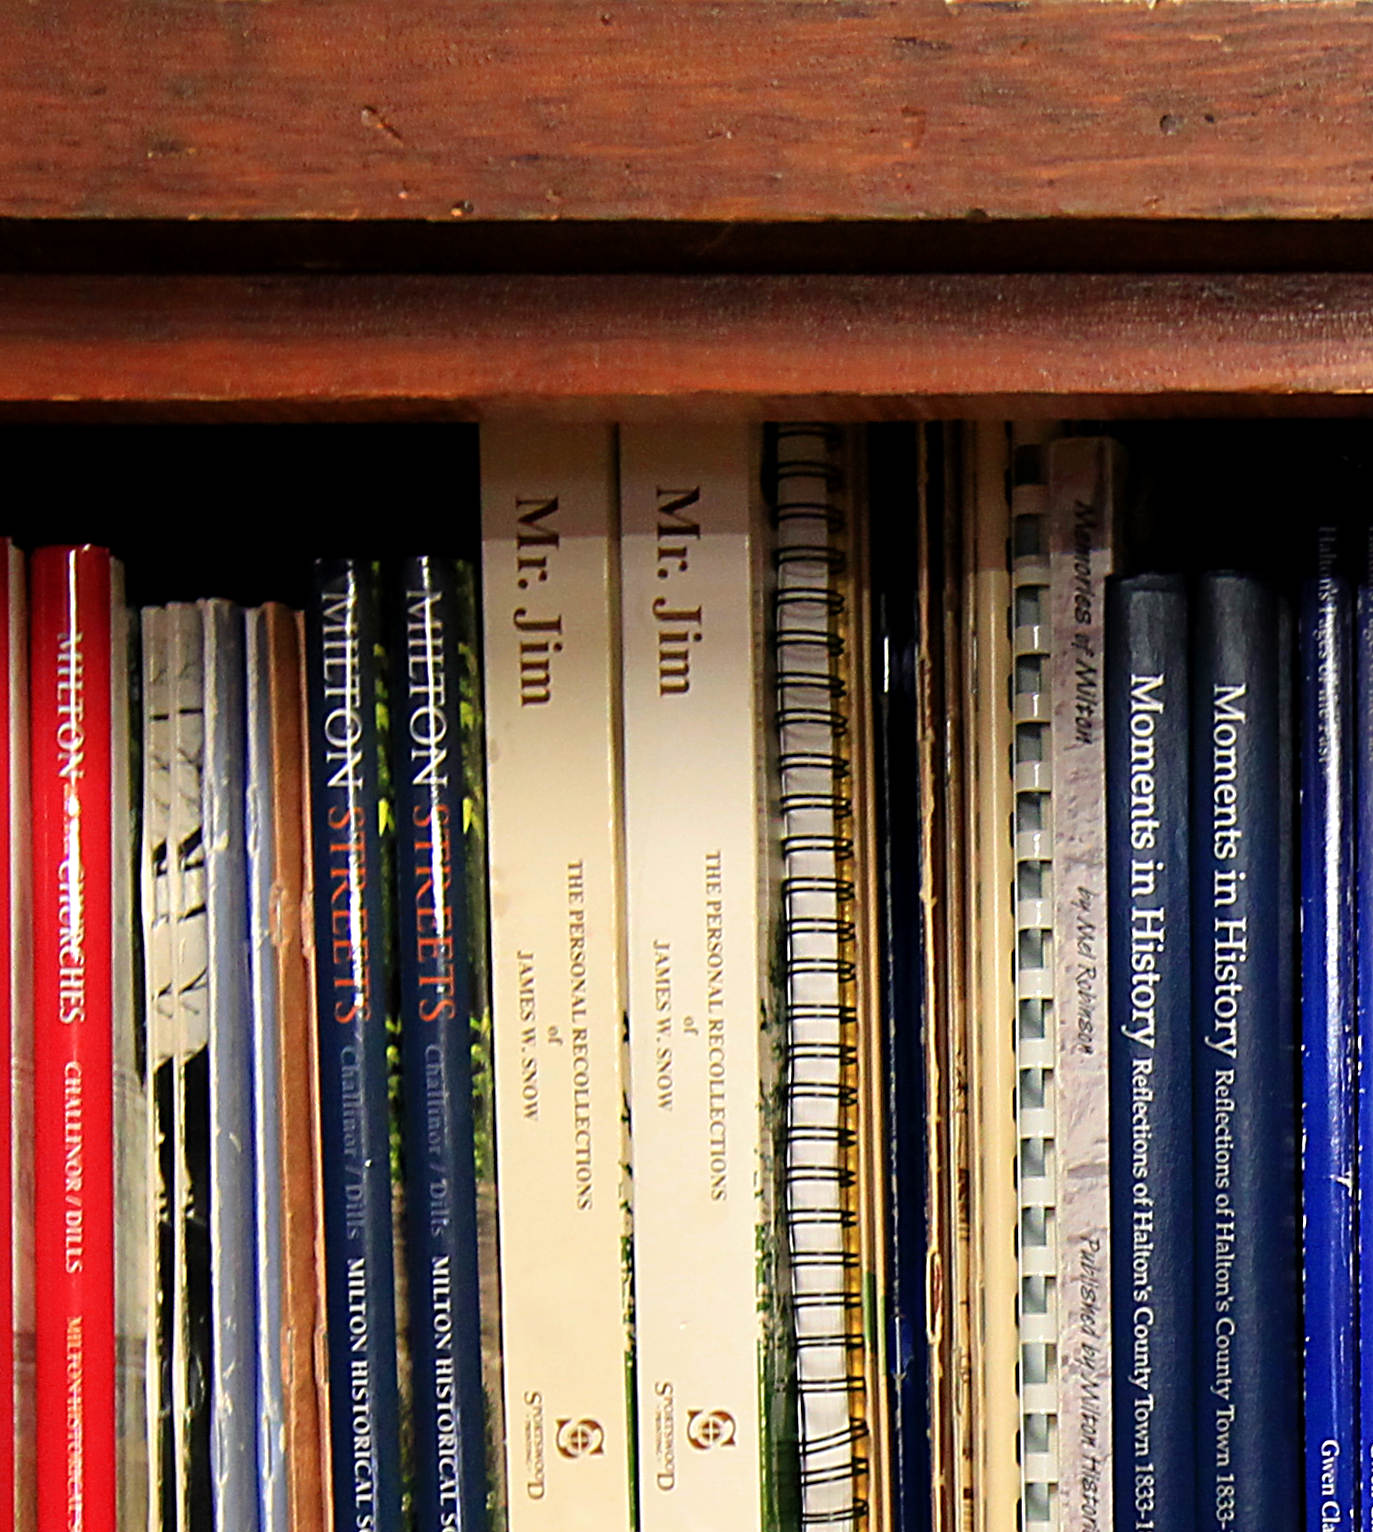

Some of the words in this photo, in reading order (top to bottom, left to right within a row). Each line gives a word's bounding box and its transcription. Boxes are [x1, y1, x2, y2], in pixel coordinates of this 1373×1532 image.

[515, 500, 561, 590] Mr.
[657, 487, 701, 579] Mr.
[512, 609, 563, 706] Jim
[653, 597, 702, 698] Jim
[1130, 674, 1163, 849] Moments
[706, 850, 722, 896] THE
[1132, 860, 1164, 896] in
[653, 940, 672, 1008] JAMES
[706, 901, 724, 1013] PERSONAL
[1122, 907, 1164, 1047] History
[655, 1016, 673, 1041] W.
[656, 1048, 675, 1111] SNOW
[707, 1019, 728, 1200] RECOLLECTIONS
[1132, 1059, 1154, 1181] Reflections
[1132, 1186, 1154, 1208] of
[1132, 1211, 1154, 1301] Halton's
[430, 1256, 453, 1349] MILTON
[1128, 1308, 1153, 1389] County
[433, 1358, 459, 1505] HISTORICAL
[1133, 1395, 1154, 1456] Town
[1320, 1440, 1340, 1495] Gwen
